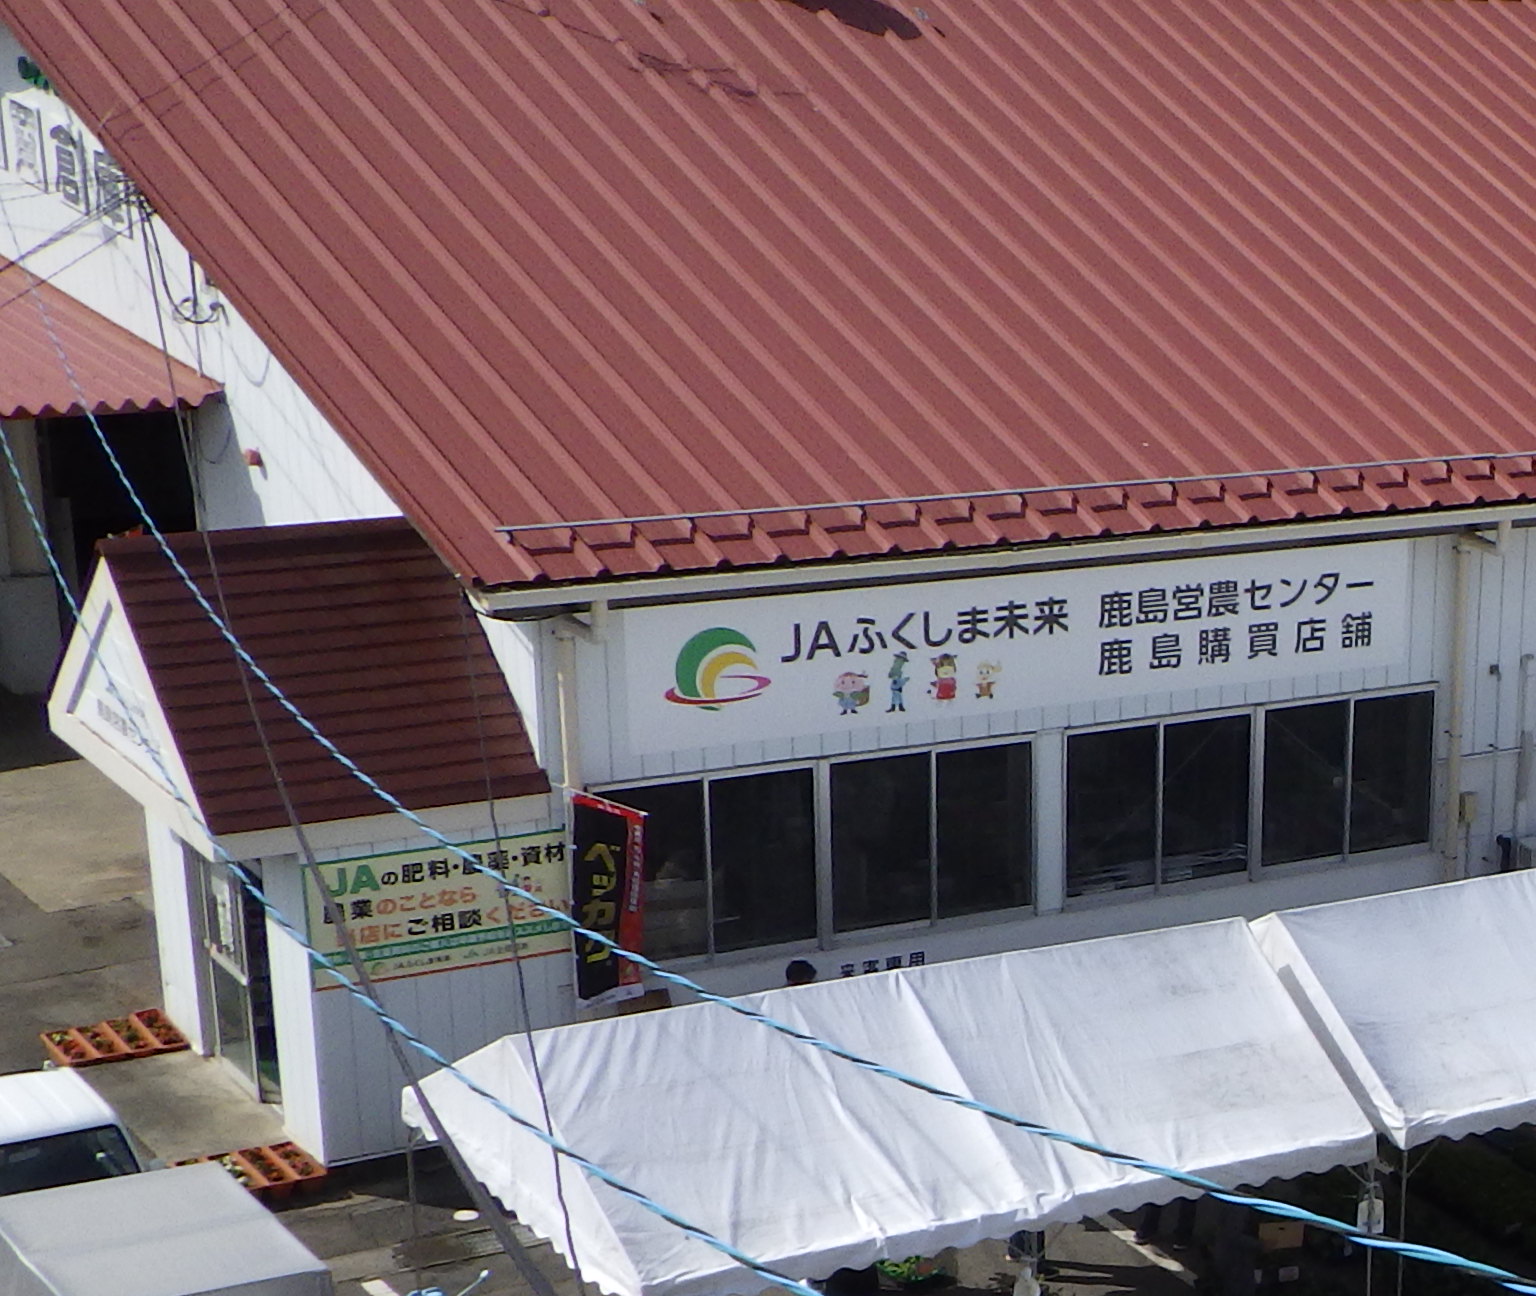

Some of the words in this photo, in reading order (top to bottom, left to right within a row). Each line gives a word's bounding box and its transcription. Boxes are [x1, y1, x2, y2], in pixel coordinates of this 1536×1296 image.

[781, 598, 1069, 663] JAふくしま未来
[1099, 571, 1376, 629] 鹿島営農センター
[1098, 613, 1374, 676] 鹿島購買店舗
